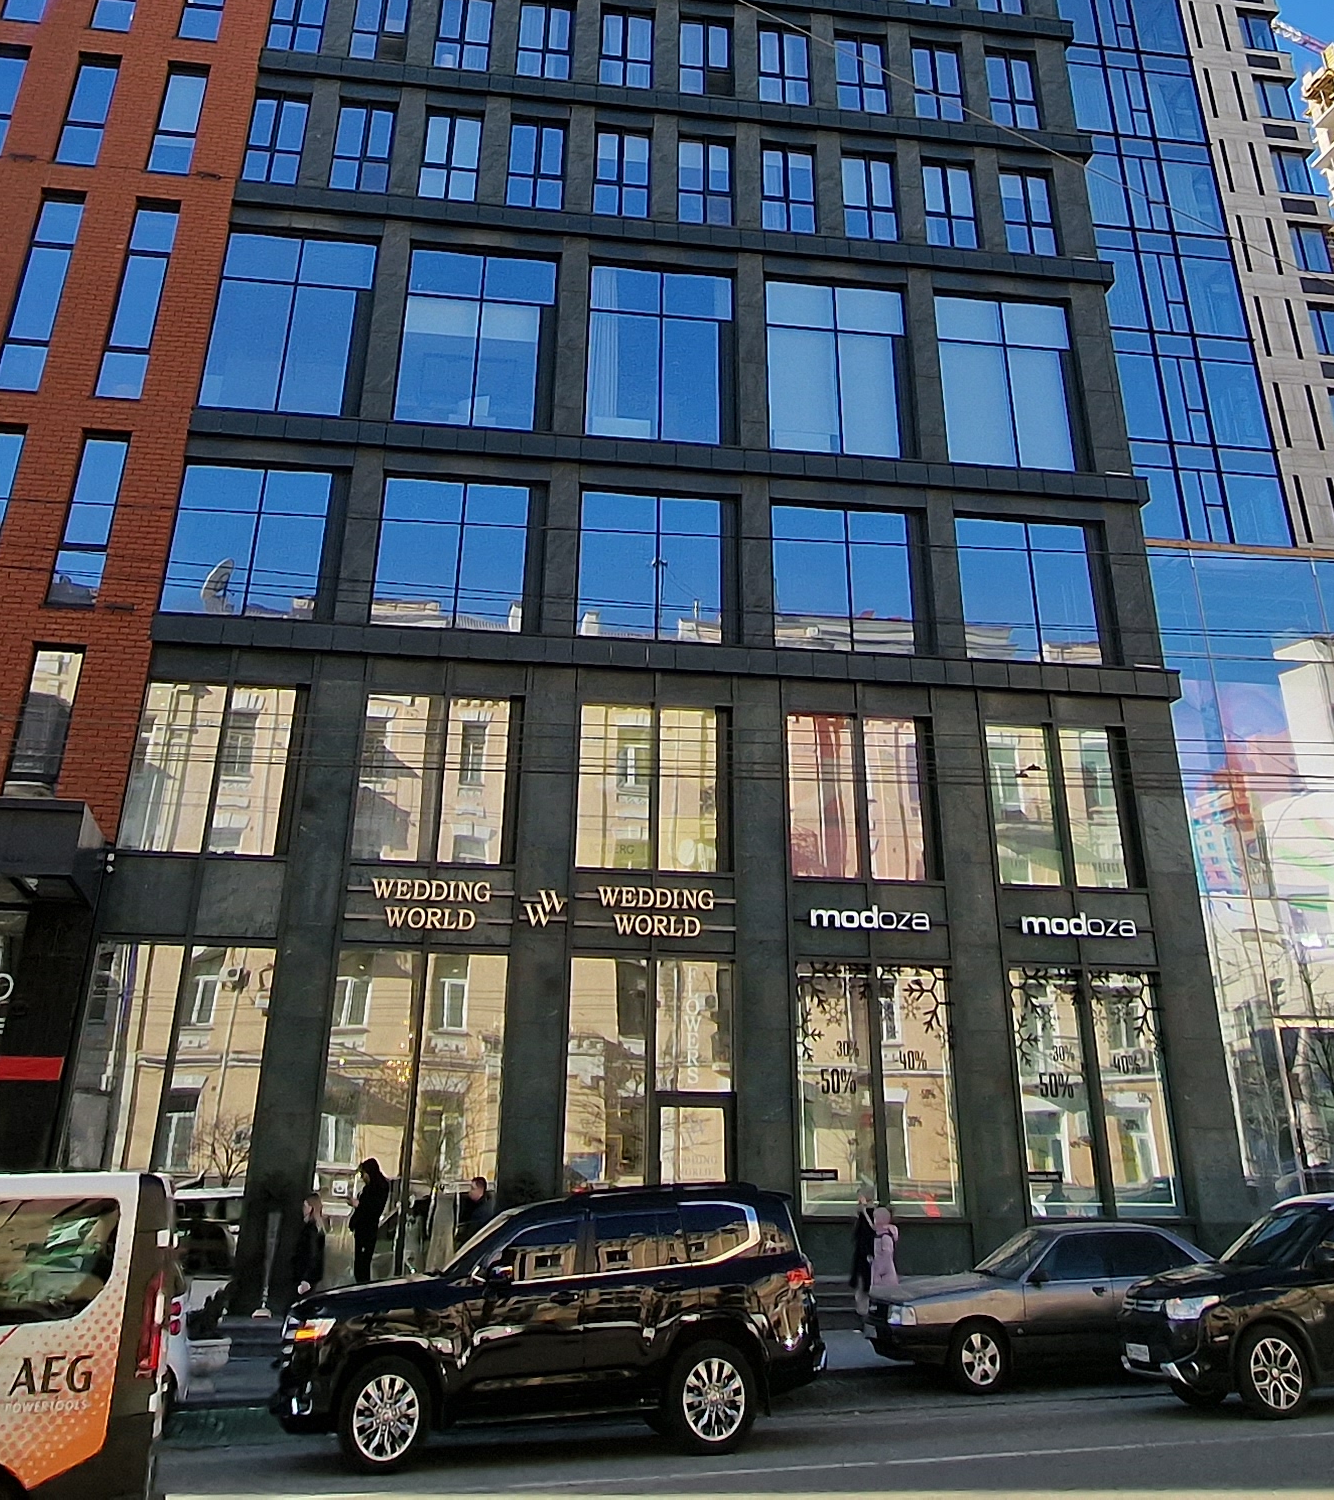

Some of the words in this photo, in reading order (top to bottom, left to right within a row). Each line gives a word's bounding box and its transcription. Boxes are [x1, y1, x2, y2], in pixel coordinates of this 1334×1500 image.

[371, 877, 492, 903] WEDDING
[597, 885, 715, 911] WEDDING
[384, 906, 476, 931] WORLD
[613, 913, 702, 937] WORLD
[810, 904, 930, 931] modoza
[1021, 911, 1137, 937] modoza
[683, 966, 704, 1084] FLOWERS
[6, 1354, 95, 1397] AEG
[4, 1399, 89, 1414] POWERTOOLS
